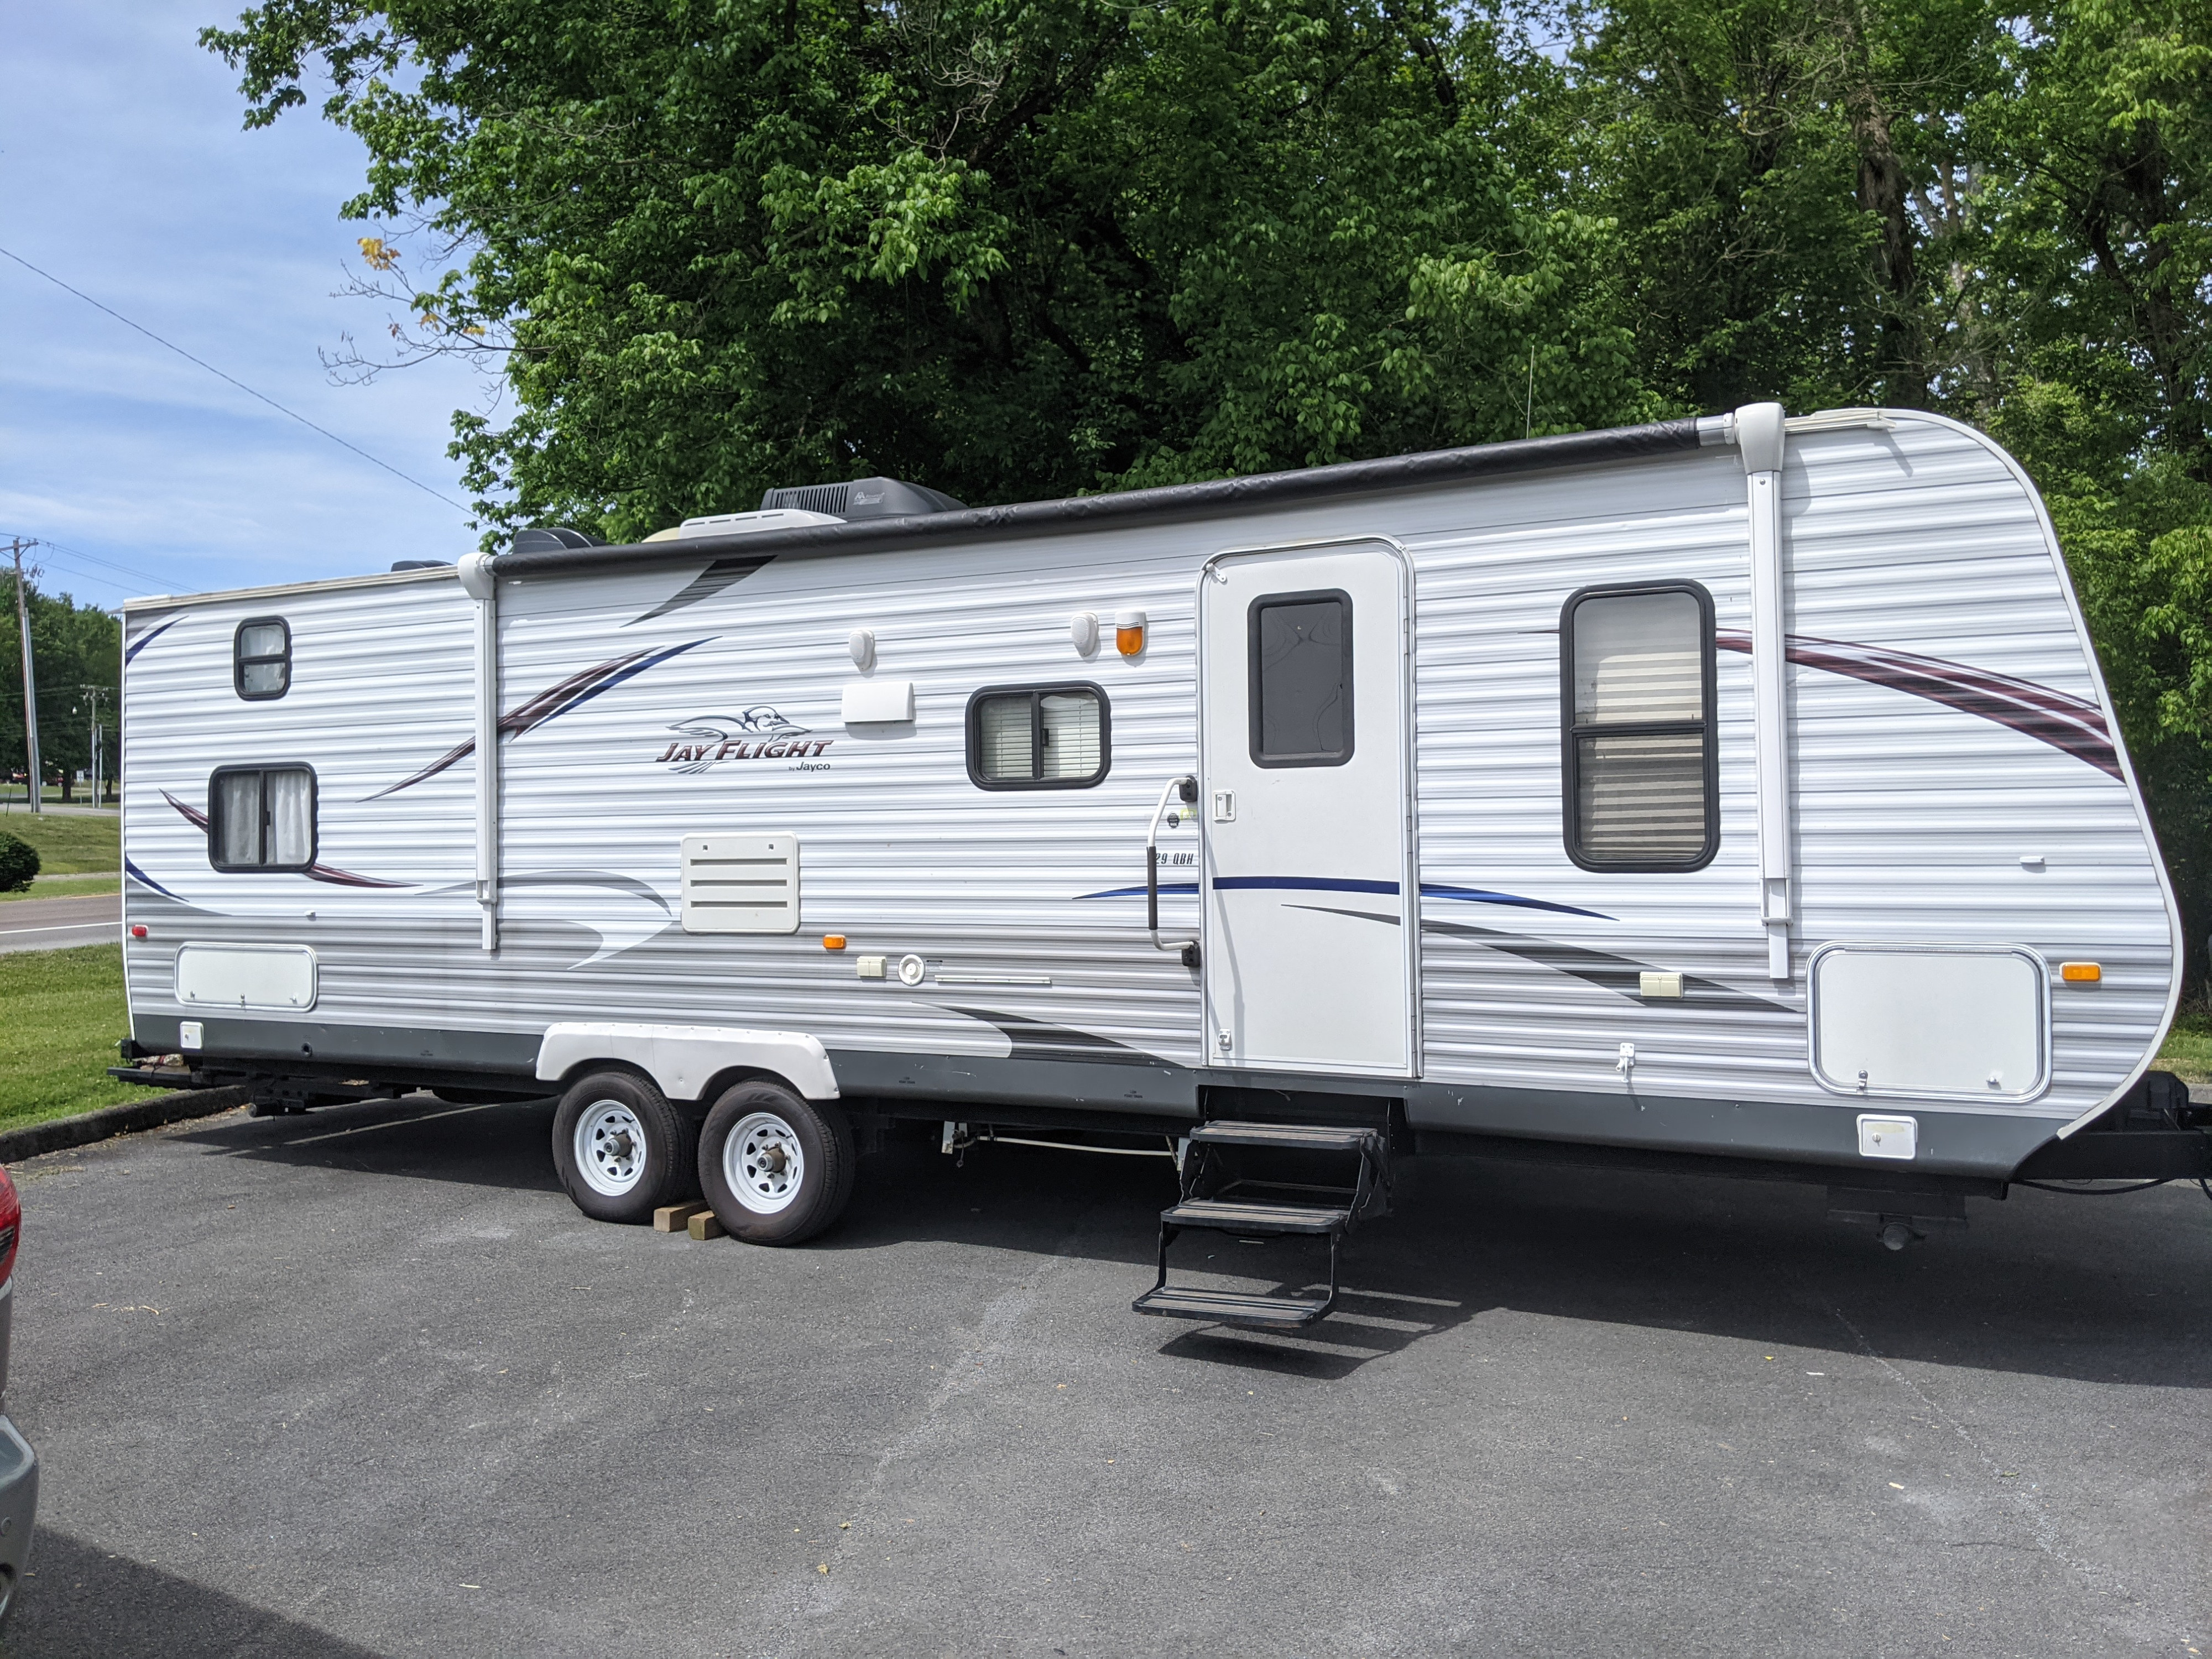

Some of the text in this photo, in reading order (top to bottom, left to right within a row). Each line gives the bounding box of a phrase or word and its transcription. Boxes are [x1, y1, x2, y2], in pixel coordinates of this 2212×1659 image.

[655, 739, 834, 762] JAY FLIGHT
[796, 761, 831, 772] Jayco
[1172, 853, 1194, 865] QBH
